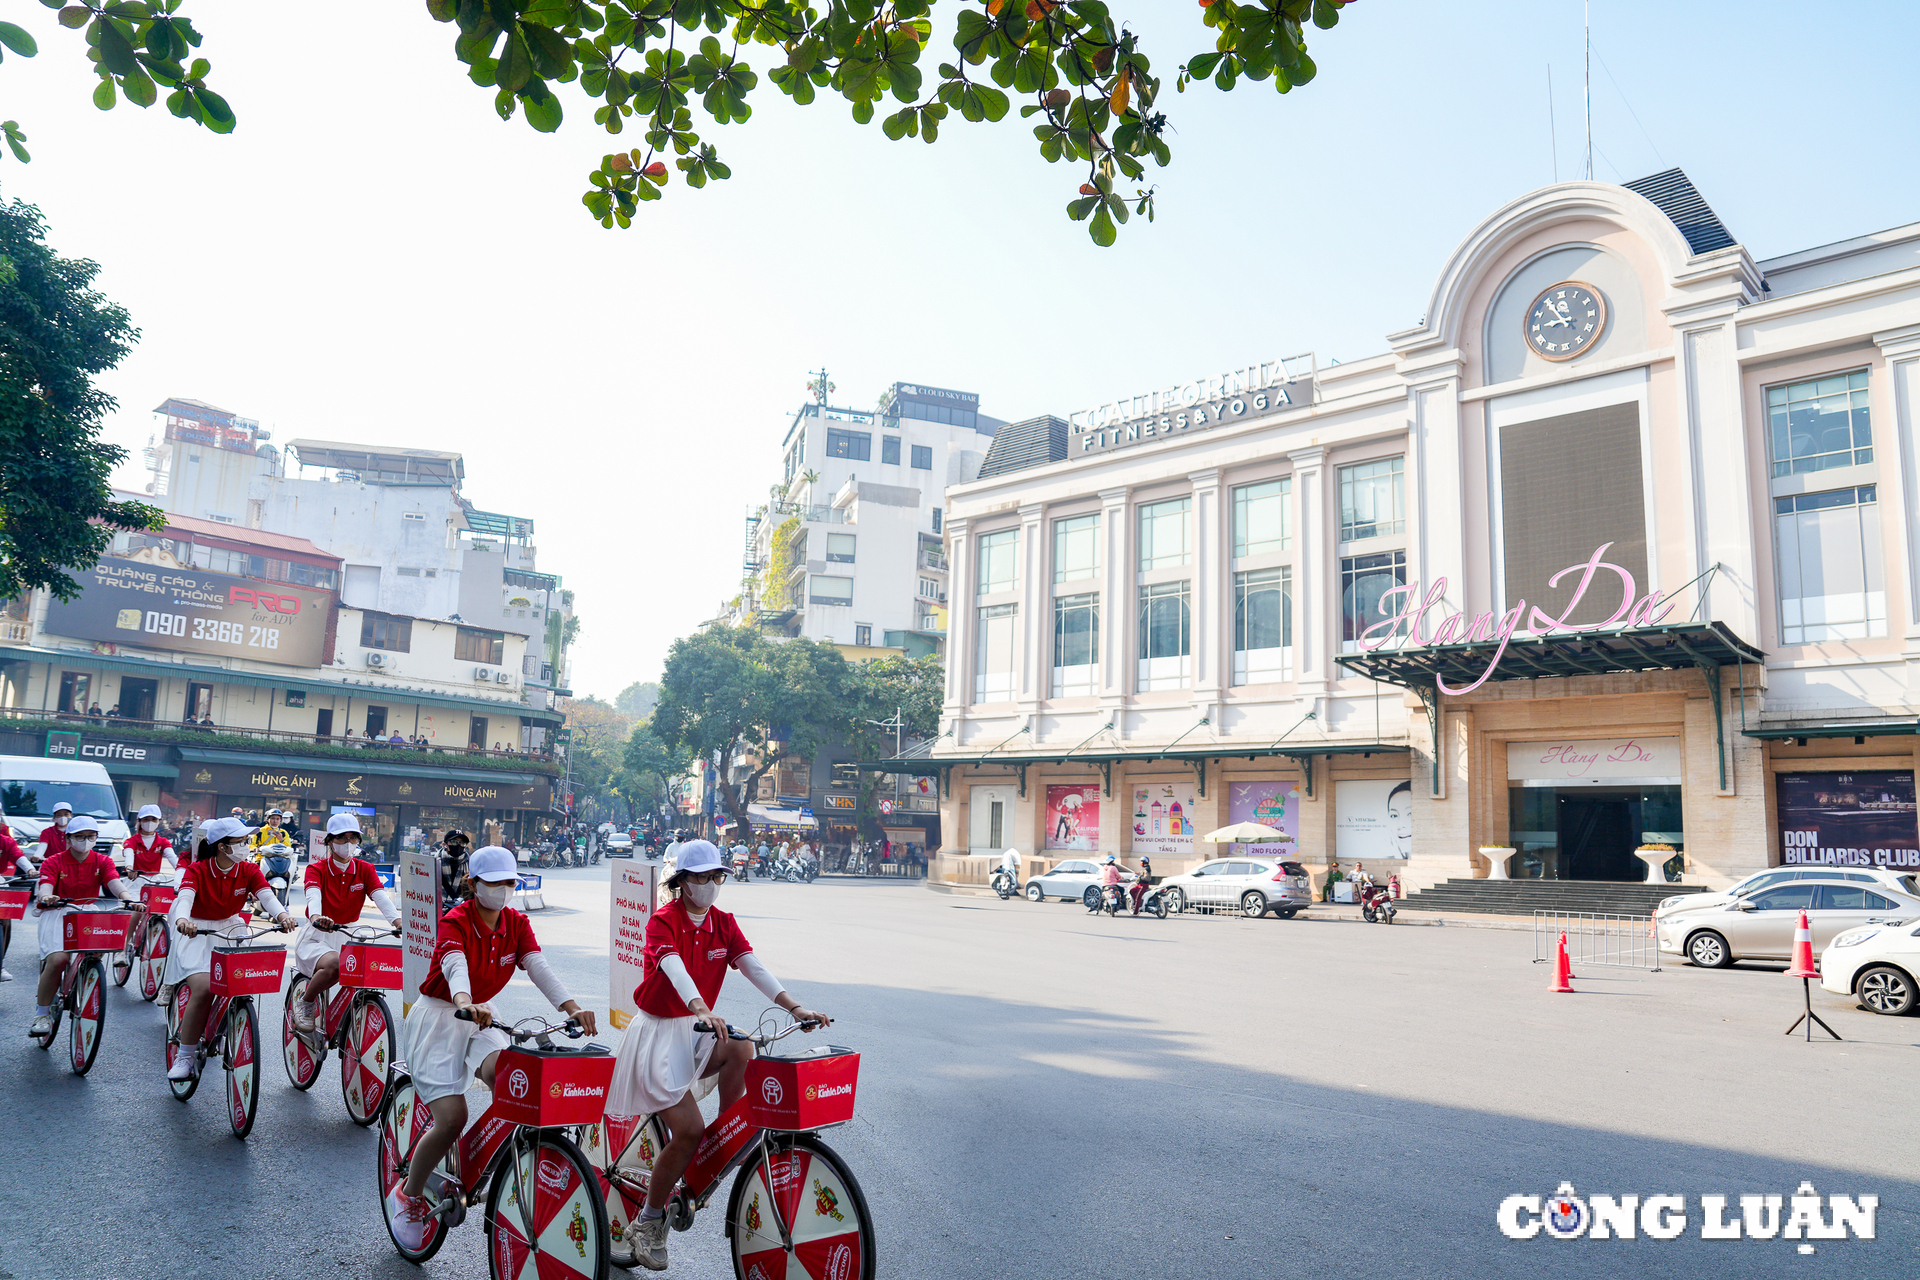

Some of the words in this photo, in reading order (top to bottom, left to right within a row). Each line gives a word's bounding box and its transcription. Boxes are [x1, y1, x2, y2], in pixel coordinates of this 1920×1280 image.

[918, 387, 945, 398] CLOUD
[945, 391, 960, 400] SKY
[961, 394, 977, 403] BAR
[1084, 357, 1292, 433] CALIFORNIA
[1082, 387, 1291, 451] FITNESS&YOGA
[95, 564, 157, 583] QUẢNG
[161, 574, 197, 589] CÁO
[95, 575, 166, 595] TRUYỀN
[170, 588, 224, 604] THÔNG
[1528, 541, 1675, 635] Da
[228, 585, 301, 616] PRO
[251, 611, 268, 622] for
[268, 614, 298, 627] ADV
[144, 610, 187, 637] 090
[191, 618, 244, 645] 3366
[248, 625, 280, 650] 218
[556, 731, 571, 742] aha
[49, 741, 76, 755] aha
[81, 742, 147, 760] coffee
[1540, 745, 1599, 778] Hàng
[1607, 740, 1656, 763] Da
[251, 772, 288, 787] HÙNG
[290, 774, 317, 788] ÁNH
[444, 785, 473, 797] HÙNG
[475, 786, 497, 799] ÁNH
[1784, 830, 1819, 848] DON
[1785, 847, 1871, 865] BILLIARDS
[1874, 848, 1920, 867] CLUB
[416, 892, 425, 902] HÀ
[616, 898, 628, 908] PHỞ
[627, 899, 637, 911] HÀ
[411, 907, 418, 917] DI
[409, 919, 420, 931] VĂN
[621, 916, 629, 925] DI
[628, 916, 640, 928] SẢN
[406, 931, 415, 942] PHI
[618, 927, 631, 939] VĂN
[630, 930, 643, 942] HÓA
[615, 939, 625, 949] PHI
[729, 1115, 741, 1128] NAM
